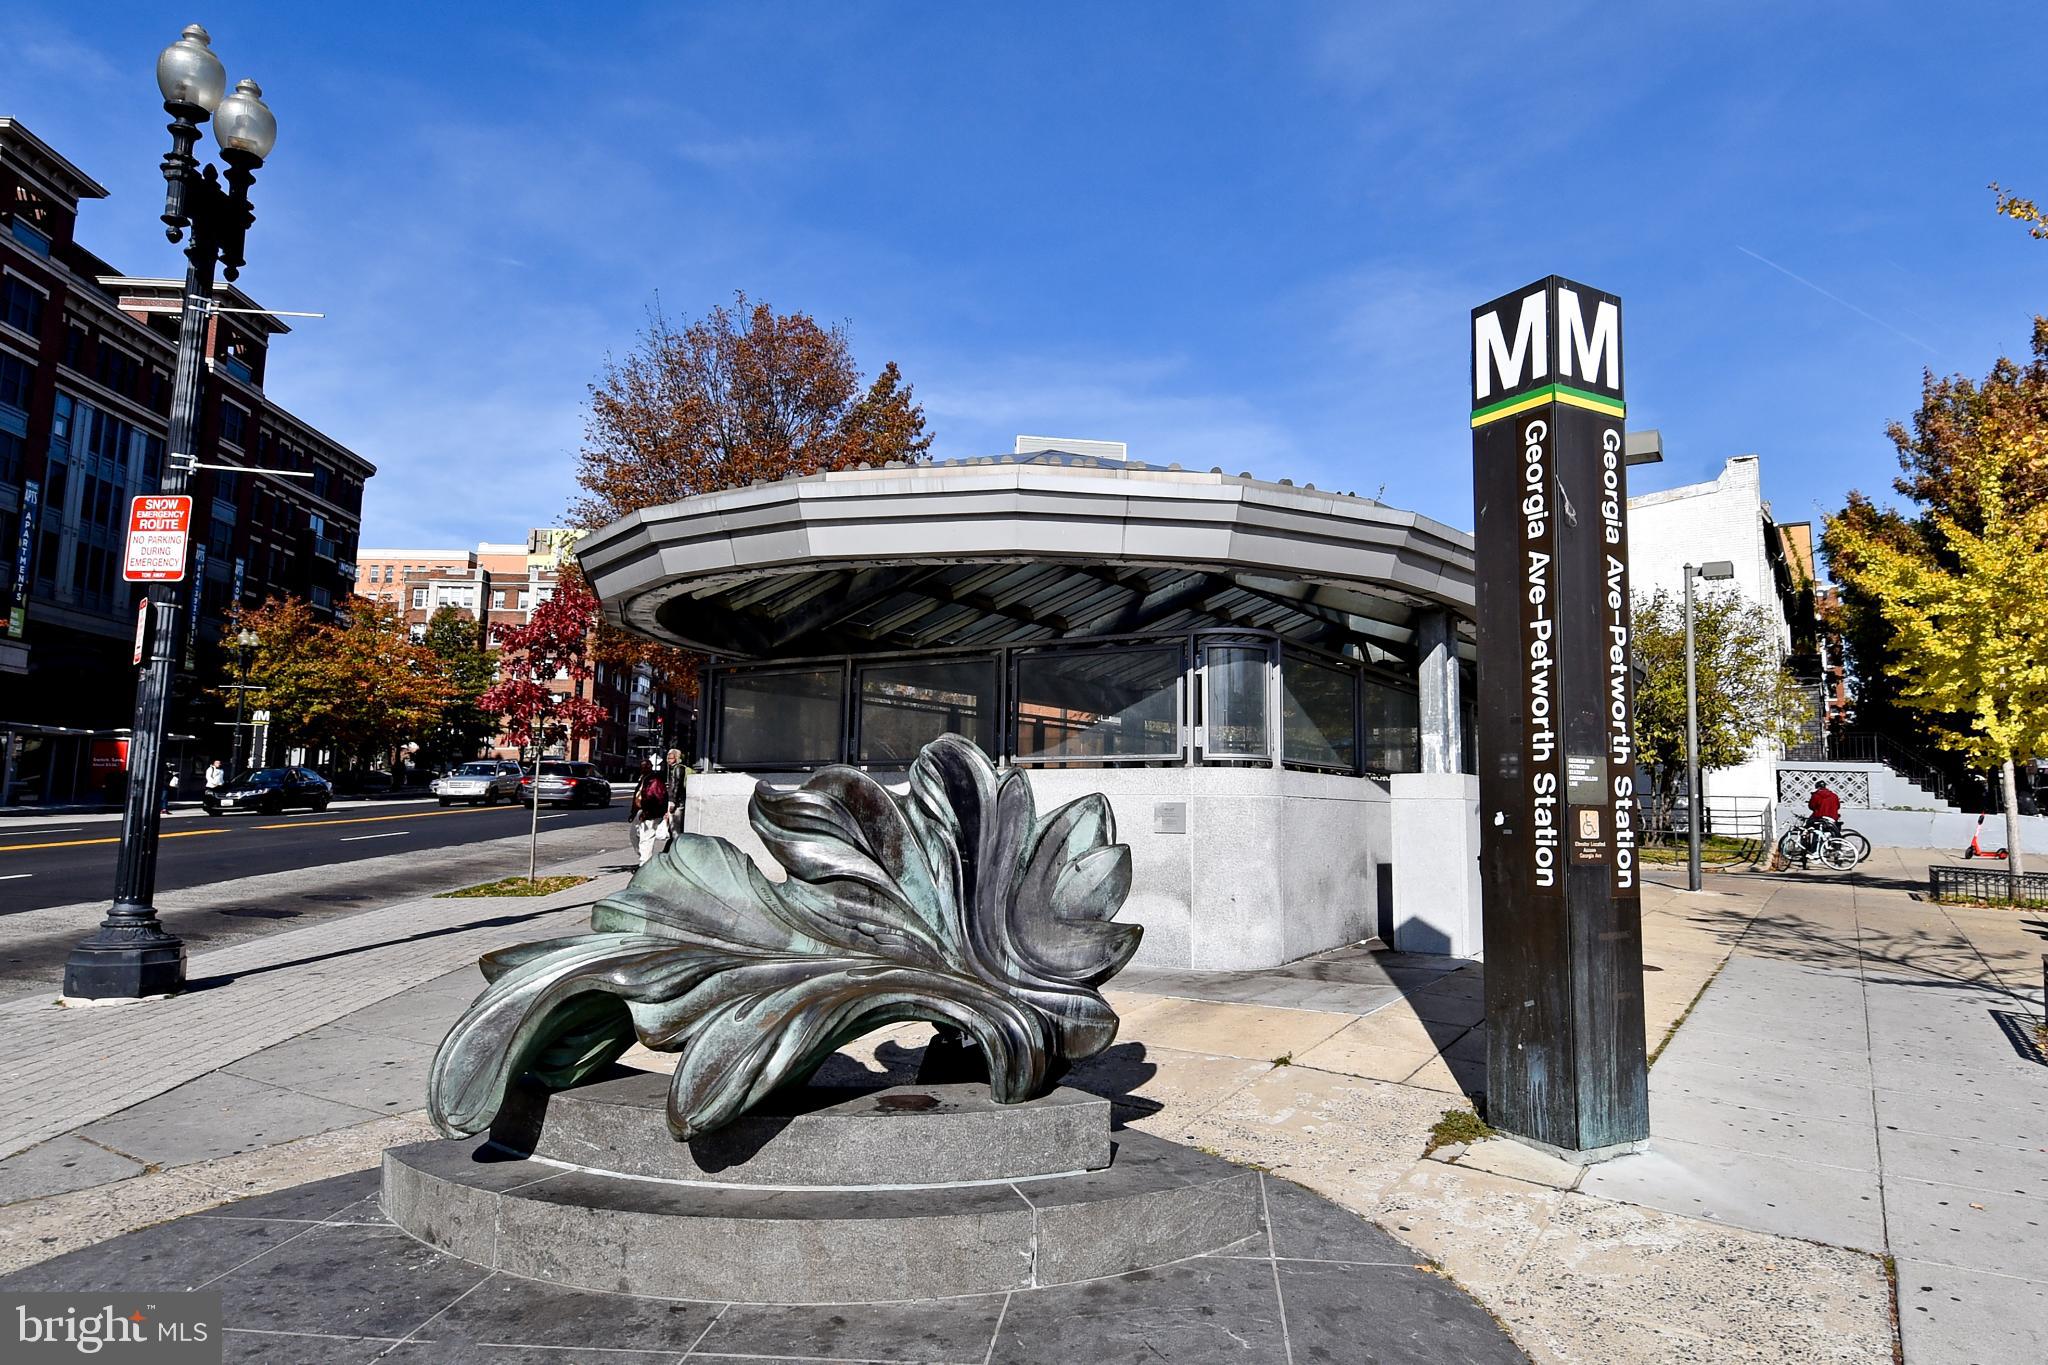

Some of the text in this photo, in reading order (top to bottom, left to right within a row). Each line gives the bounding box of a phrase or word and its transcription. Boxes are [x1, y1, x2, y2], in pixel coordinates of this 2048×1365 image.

[1475, 289, 1548, 400] M
[1557, 287, 1619, 390] M
[145, 499, 179, 510] SNOW
[1522, 420, 1549, 539] Georgia
[132, 535, 182, 545] NO PARKING
[136, 511, 185, 519] EMERGENCY
[139, 519, 180, 530] ROUTE
[16, 511, 32, 601] APARTMENTS
[130, 557, 180, 567] EMERGENCY
[141, 546, 171, 556] DURING
[1601, 428, 1623, 544] Georgia
[1614, 775, 1635, 888] Station
[1533, 772, 1558, 887] Station
